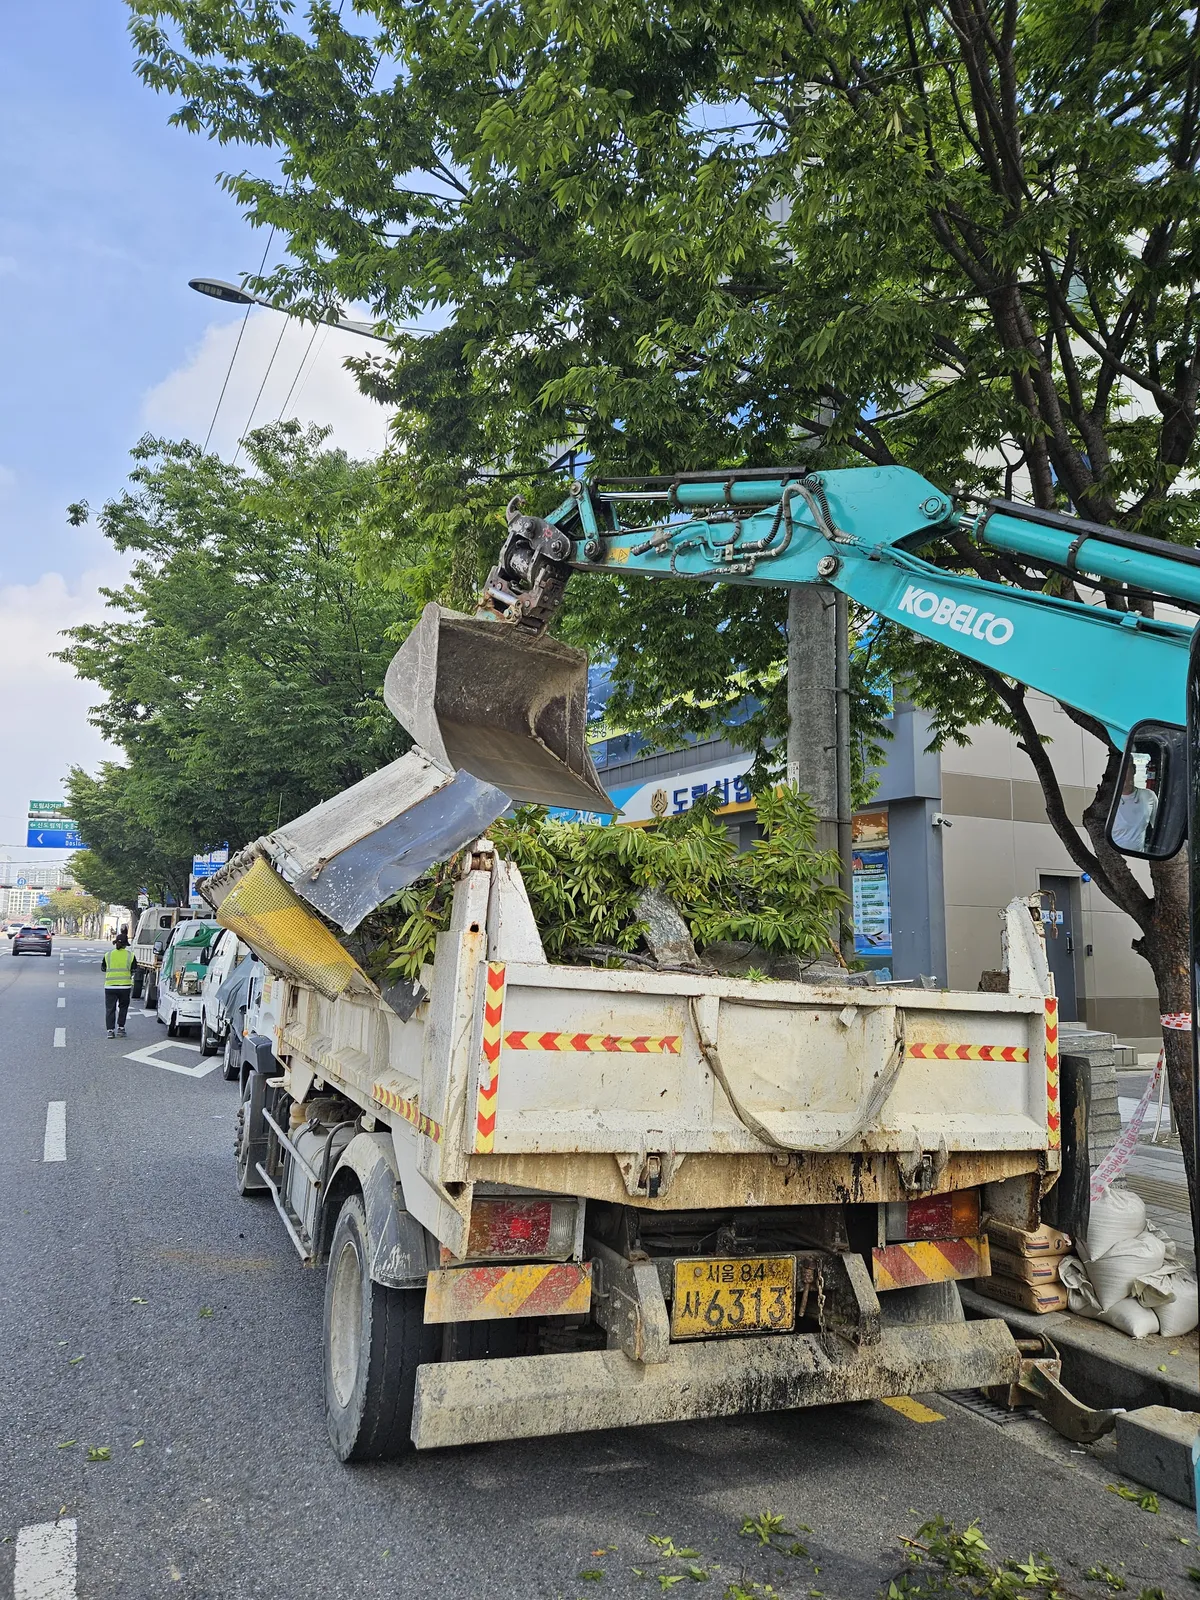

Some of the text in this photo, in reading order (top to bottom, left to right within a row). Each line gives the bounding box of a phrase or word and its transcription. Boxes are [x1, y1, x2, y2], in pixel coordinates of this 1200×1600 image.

[898, 585, 1014, 645] KOBELCO
[707, 1263, 765, 1283] 서울 84
